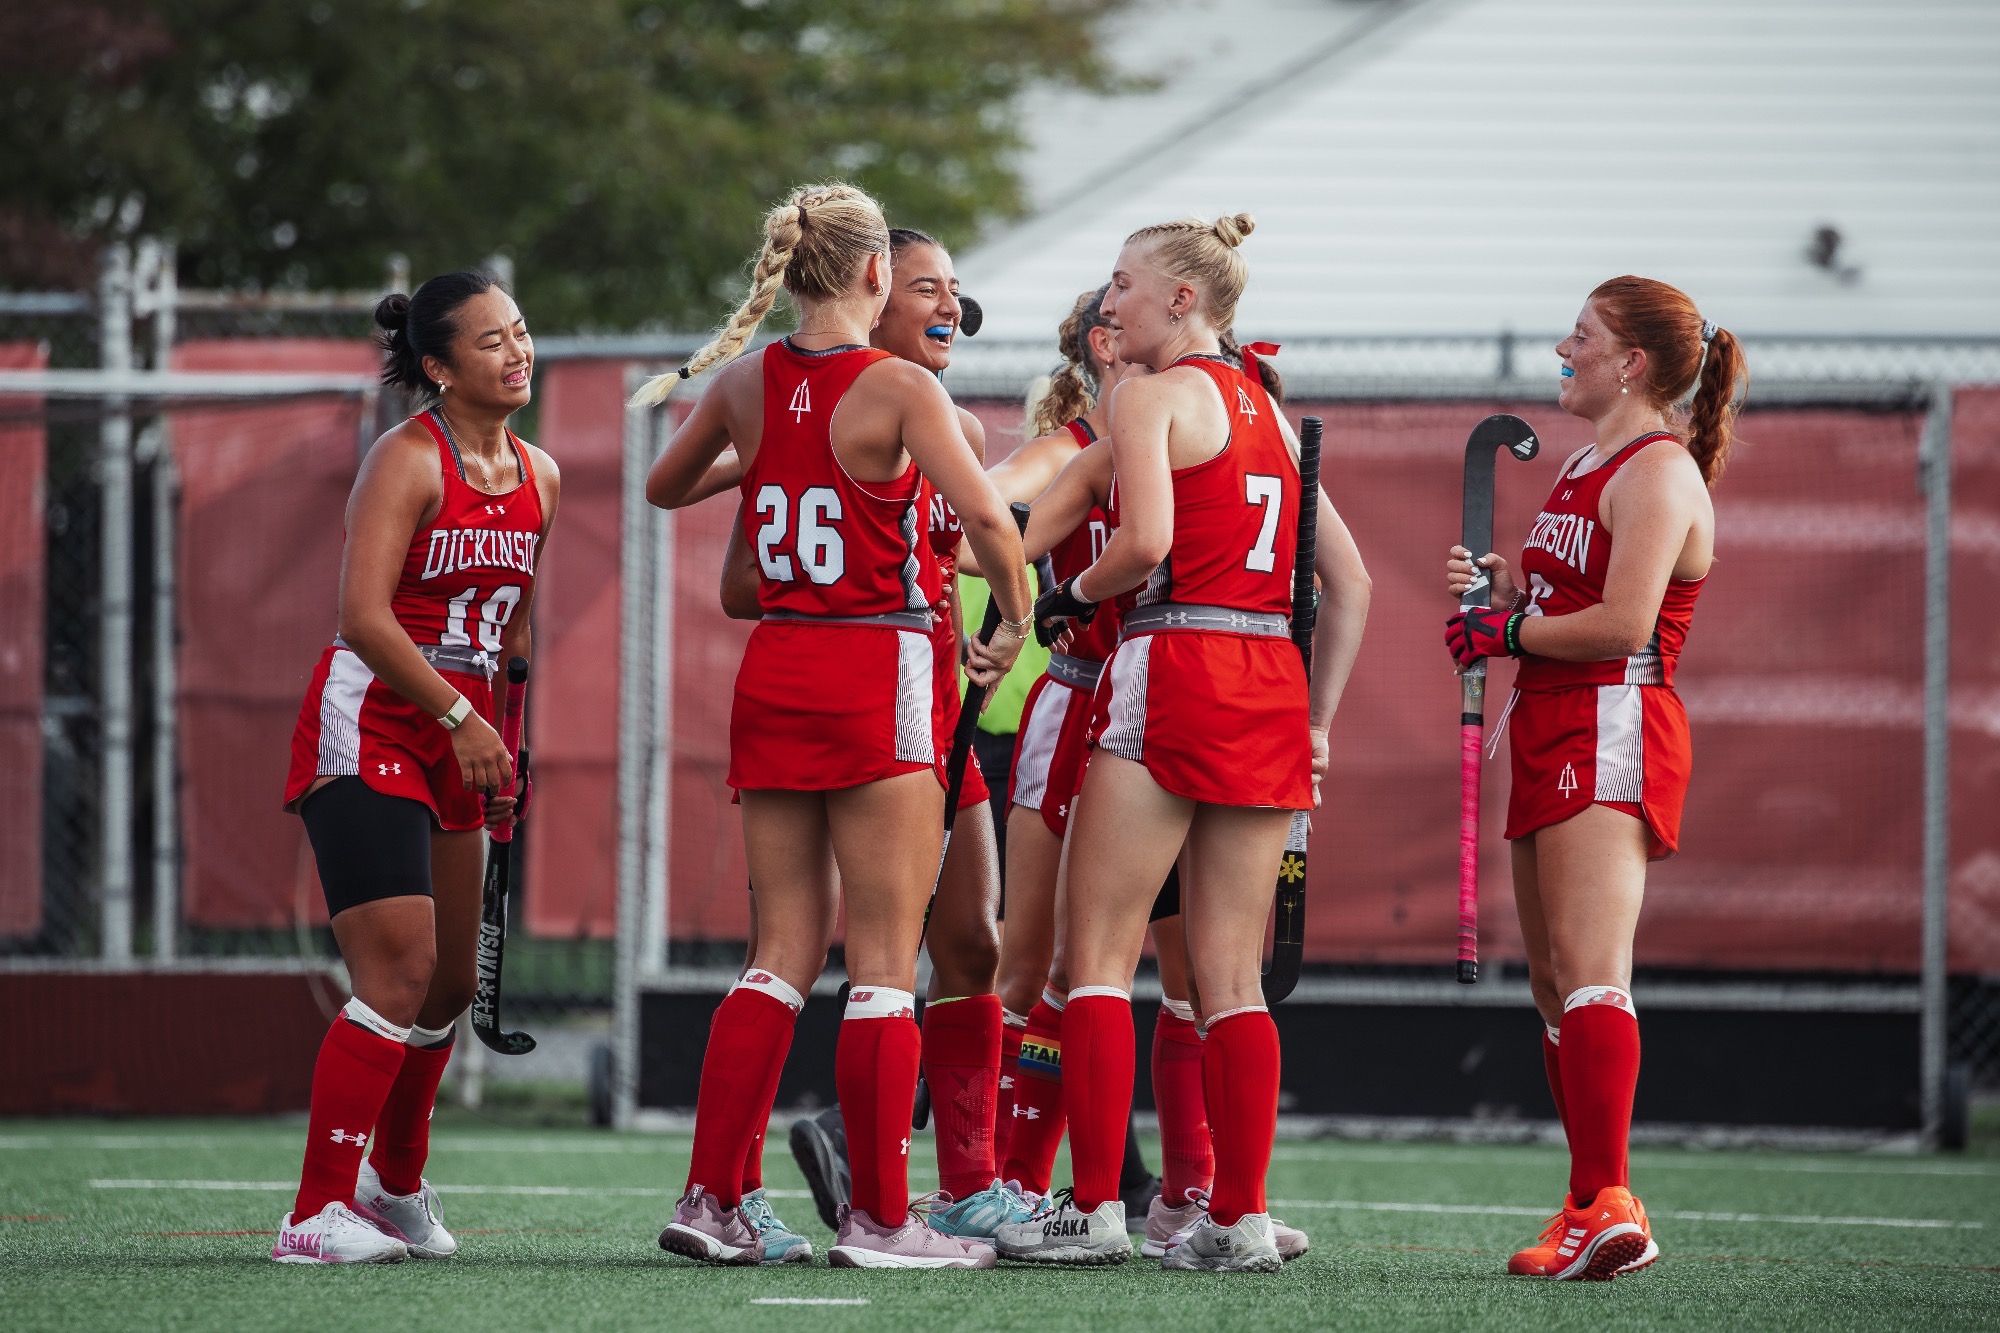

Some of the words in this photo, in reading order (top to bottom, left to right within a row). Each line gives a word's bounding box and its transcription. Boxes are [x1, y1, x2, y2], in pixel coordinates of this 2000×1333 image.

[757, 486, 843, 584] 26
[928, 493, 964, 532] NS
[1245, 474, 1282, 573] 7
[421, 528, 540, 580] DICKINSO
[1523, 510, 1594, 575] KINSON
[477, 921, 501, 979] OSAKA
[1021, 1043, 1061, 1066] PTAI
[281, 1230, 322, 1251] OSAKA
[1043, 1218, 1090, 1236] OSAKA
